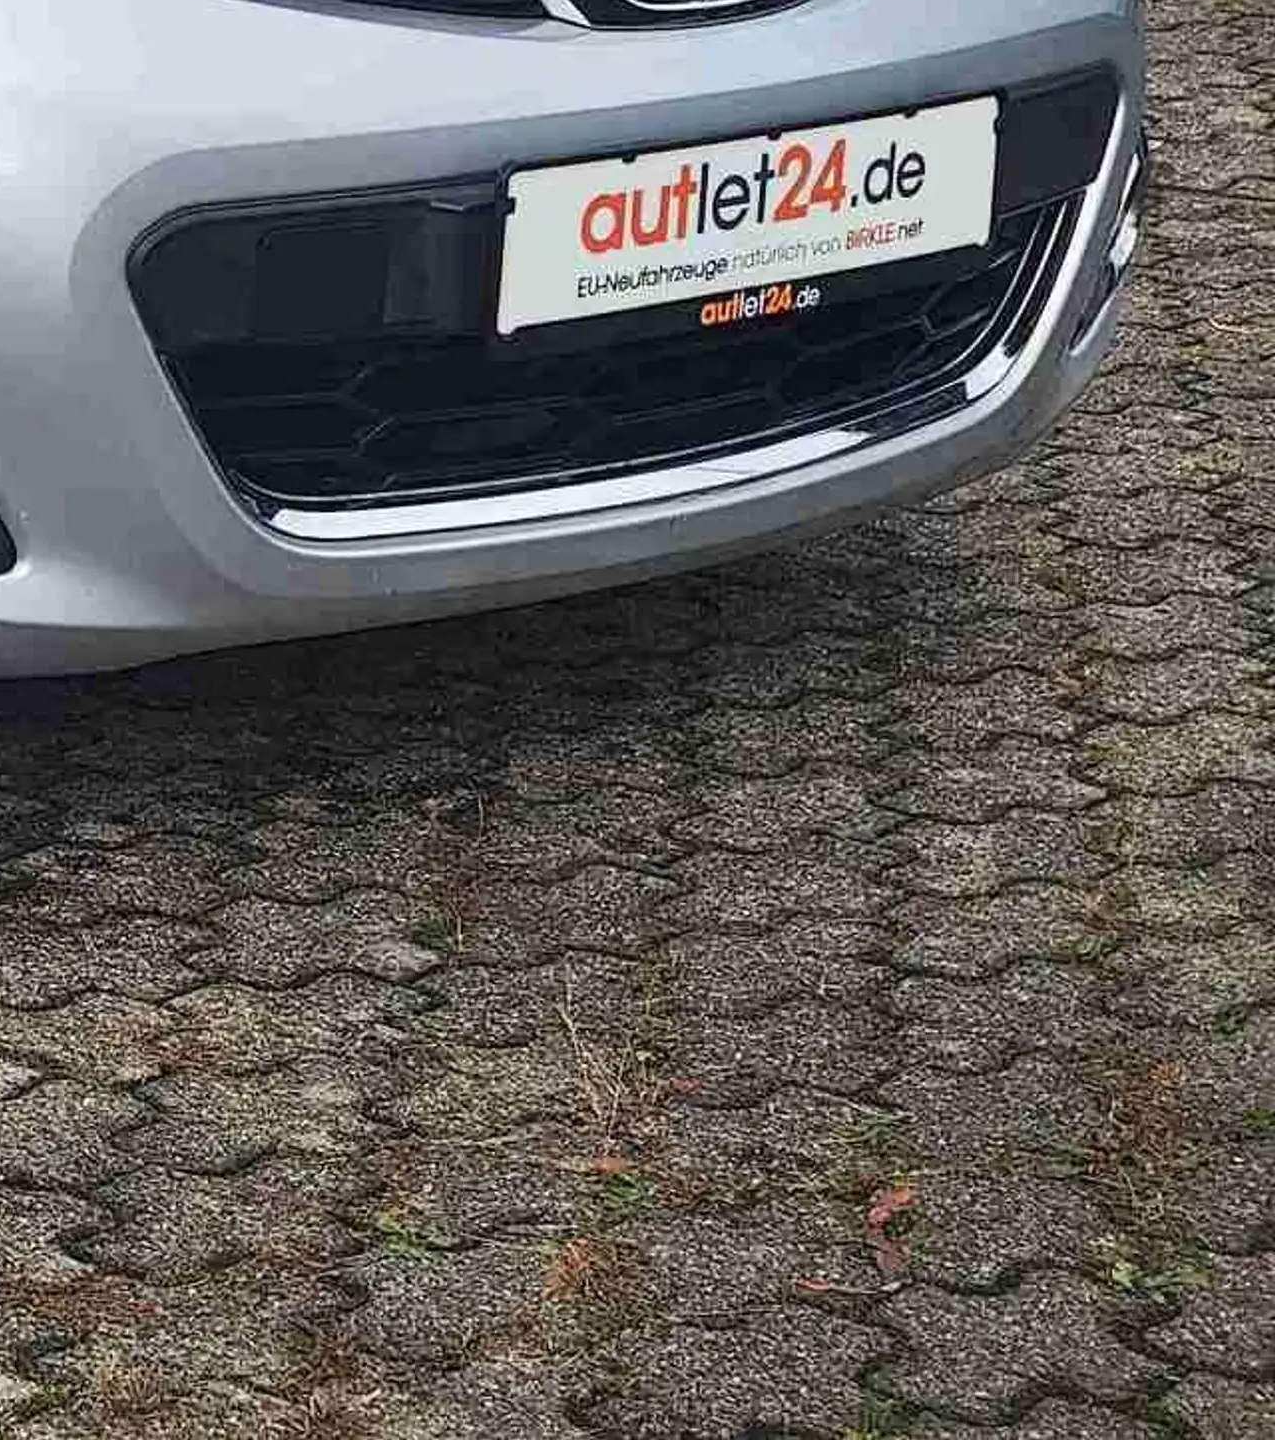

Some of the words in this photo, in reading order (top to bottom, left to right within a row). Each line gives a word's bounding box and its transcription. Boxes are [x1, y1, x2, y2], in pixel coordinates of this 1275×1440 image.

[581, 139, 926, 253] autlet24.de
[577, 257, 728, 298] EU-Neufahrzeuge
[812, 237, 842, 256] von
[701, 283, 821, 325] autlet24.de
